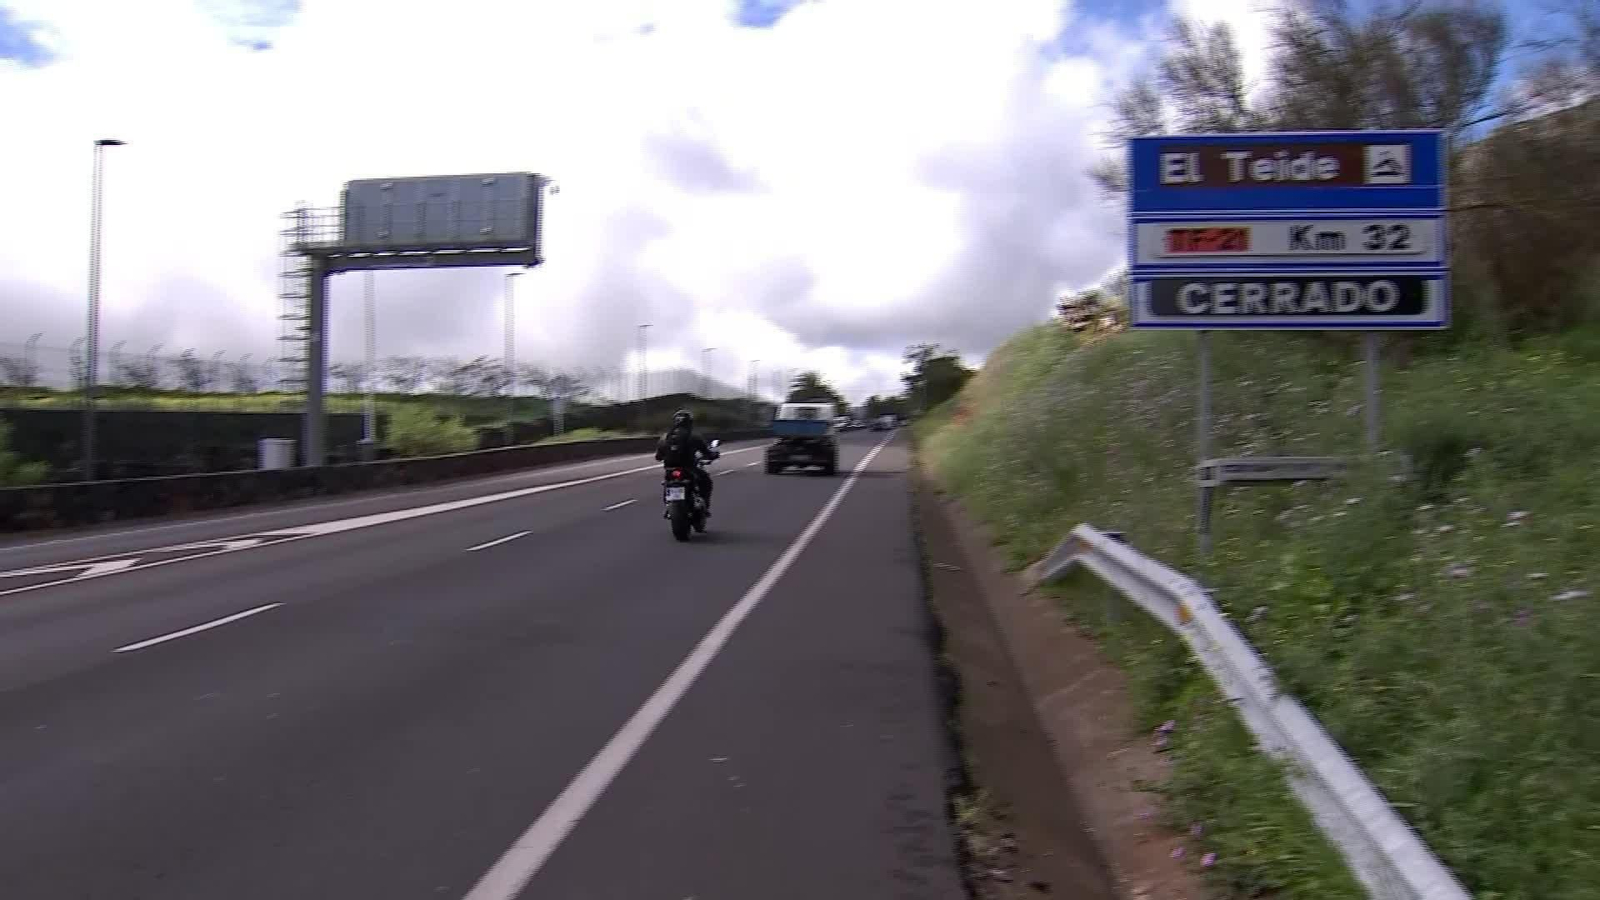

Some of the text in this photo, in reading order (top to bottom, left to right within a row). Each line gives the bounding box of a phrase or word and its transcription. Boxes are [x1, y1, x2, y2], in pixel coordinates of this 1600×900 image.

[1160, 150, 1340, 184] El Teide
[1289, 225, 1346, 251] Km
[1363, 224, 1411, 250] 32
[1177, 280, 1400, 314] CERRADO
